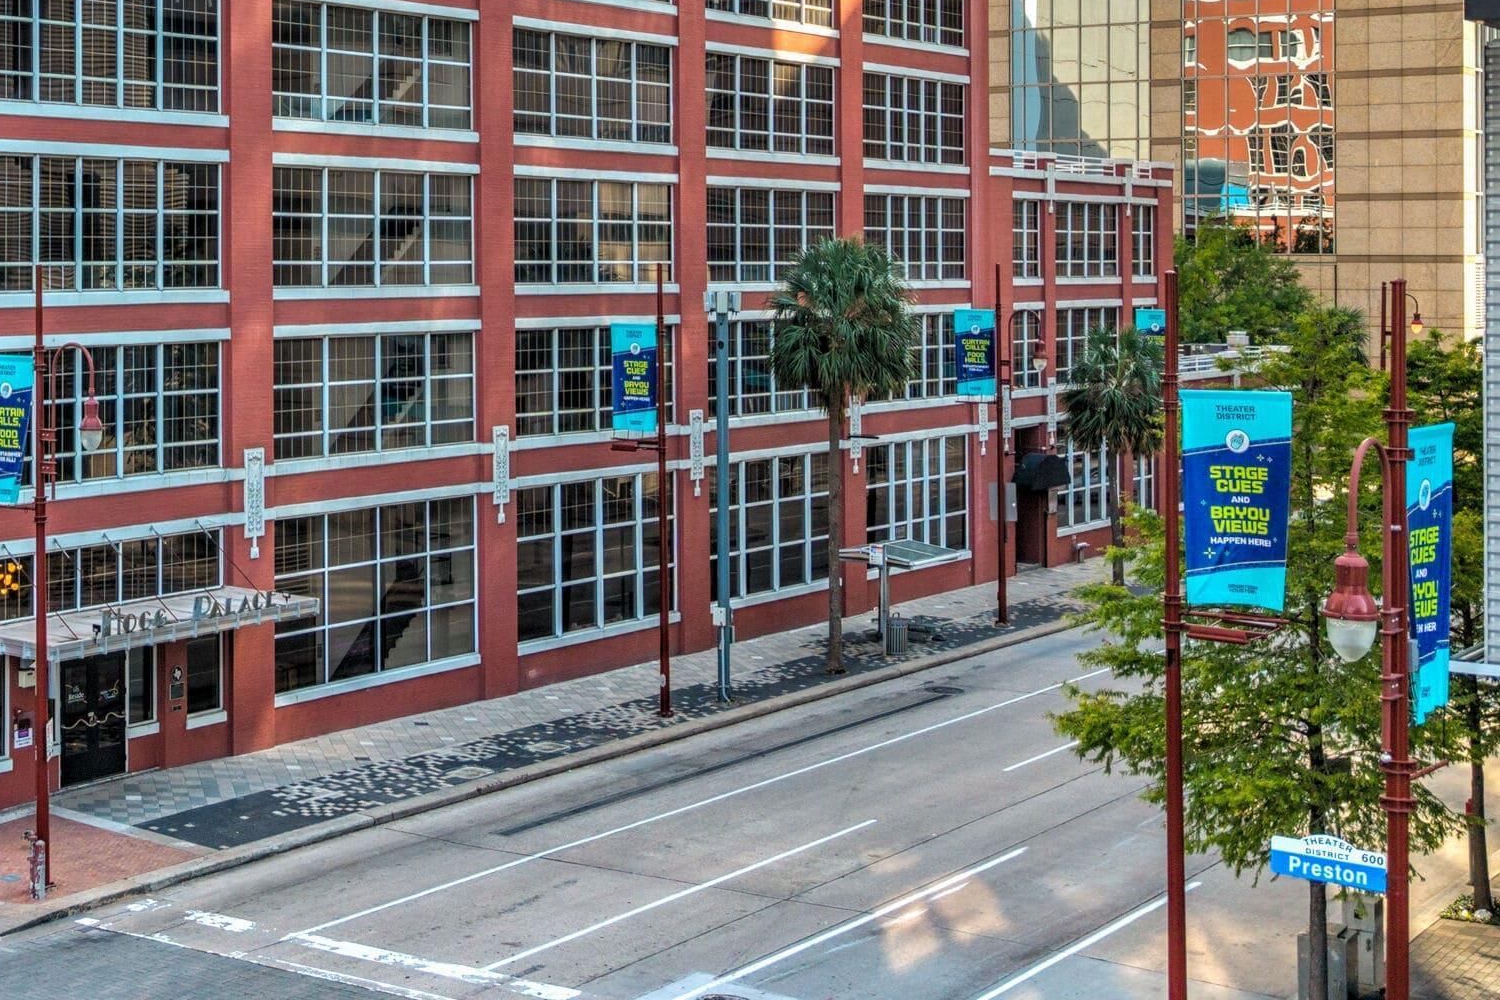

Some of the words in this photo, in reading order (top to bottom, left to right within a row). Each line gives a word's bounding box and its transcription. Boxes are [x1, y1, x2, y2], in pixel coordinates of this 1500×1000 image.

[1216, 405, 1256, 413] THEATER
[1216, 413, 1256, 421] DISTRICT
[1209, 465, 1269, 481] STAGE
[1216, 479, 1264, 494] CUES
[1231, 495, 1251, 504] AND
[1210, 505, 1270, 521] BAYOU
[1213, 519, 1269, 535] VIEWS
[1210, 536, 1248, 545] HAPPEN
[1247, 538, 1272, 547] HERE!
[1410, 525, 1440, 548] STAGE
[1411, 544, 1436, 566] CUES
[1415, 567, 1428, 579] AND
[192, 591, 276, 619] PALACE
[1414, 598, 1438, 619] EWS
[1303, 836, 1353, 854] THEATER
[1305, 847, 1350, 861] DISTRICT
[1361, 852, 1385, 866] 600
[1288, 855, 1368, 886] Preston
